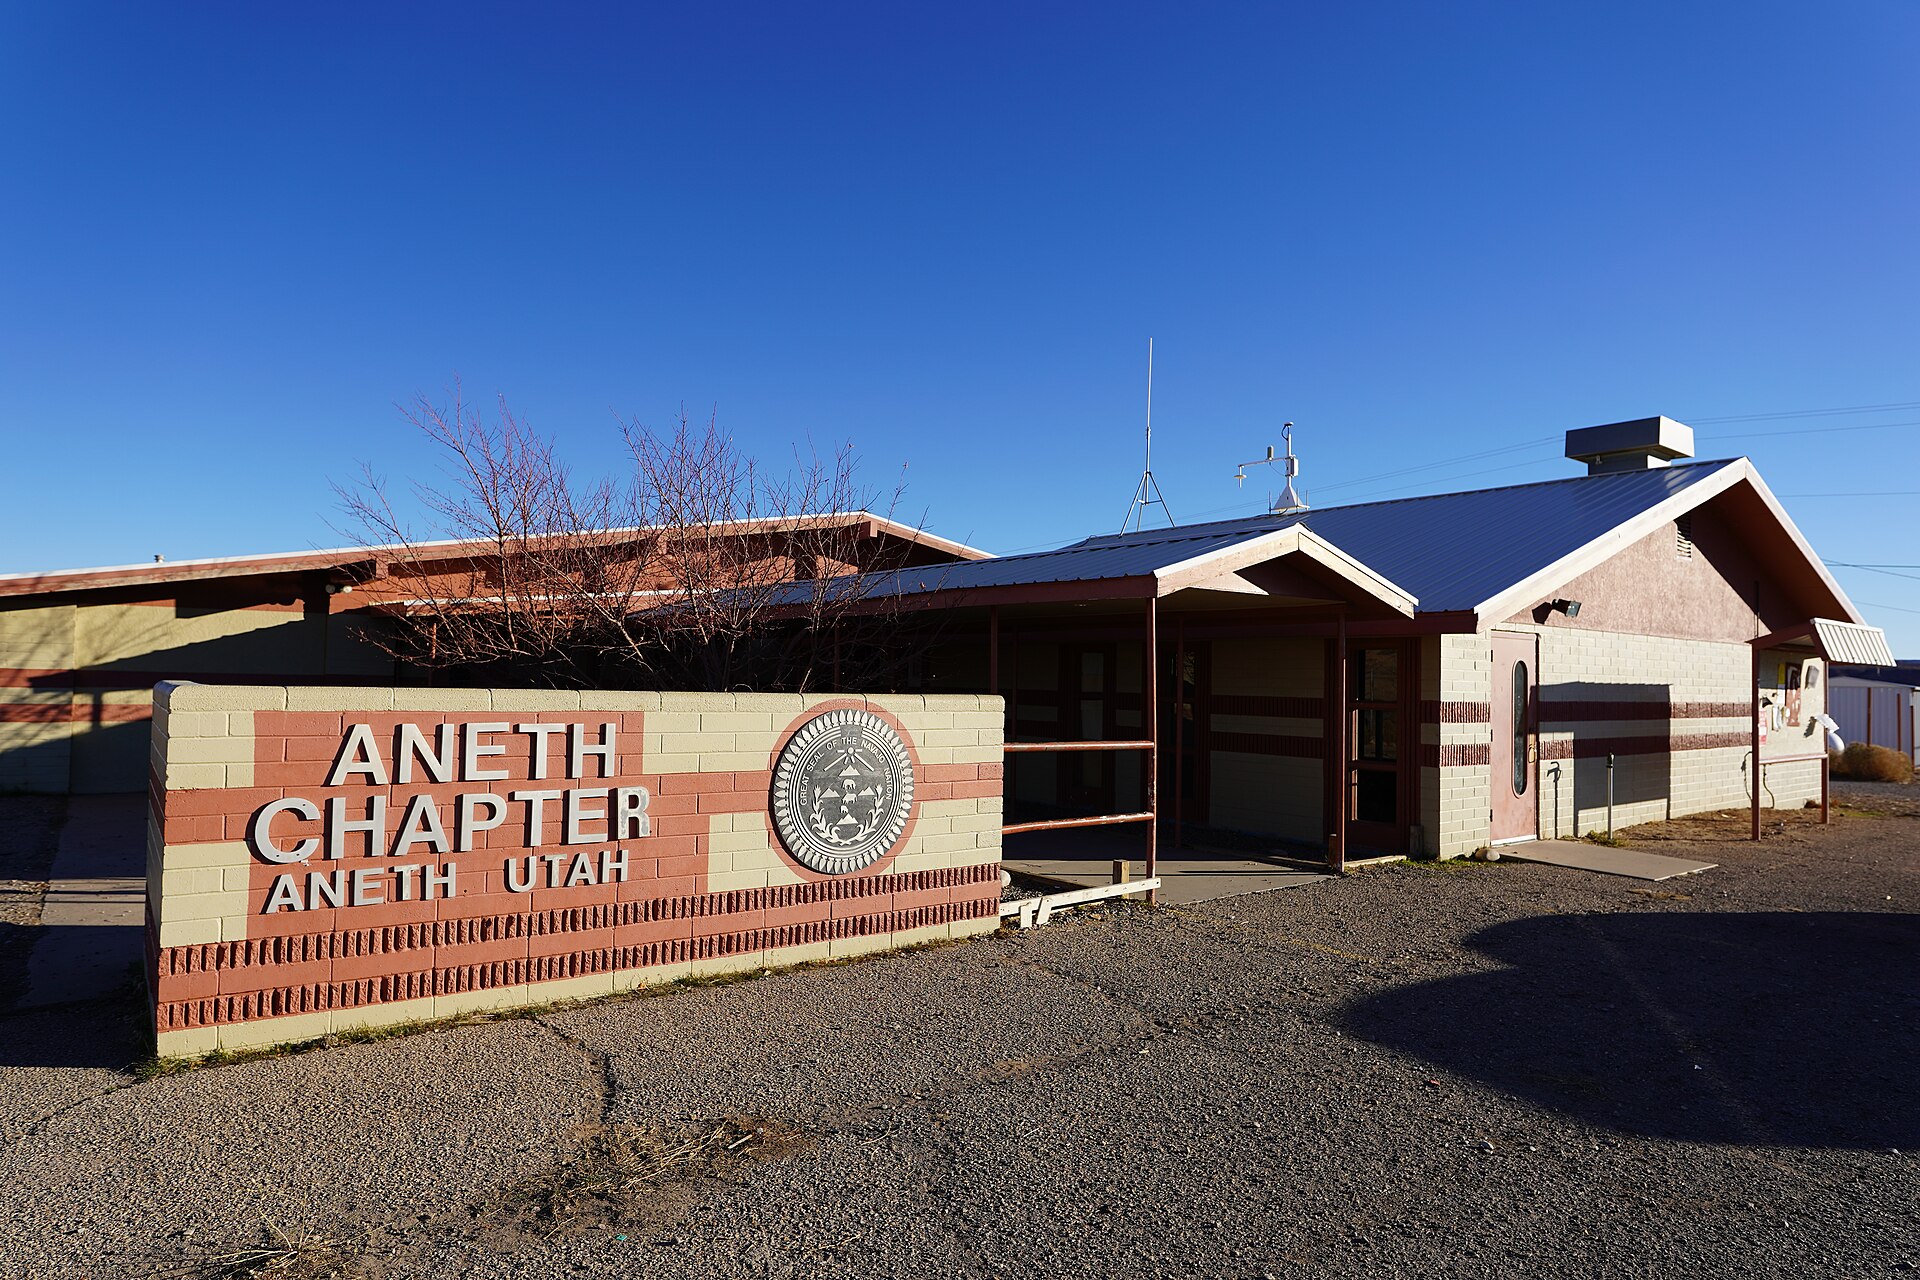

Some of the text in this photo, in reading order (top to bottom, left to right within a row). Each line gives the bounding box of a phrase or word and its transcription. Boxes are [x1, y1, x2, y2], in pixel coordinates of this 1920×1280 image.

[329, 721, 617, 786] ANETH
[800, 737, 892, 806] GREAT SEAL OF THE NAVAJO NATION
[254, 786, 651, 864] CHAPTER
[266, 849, 629, 914] ANETH UTAH
